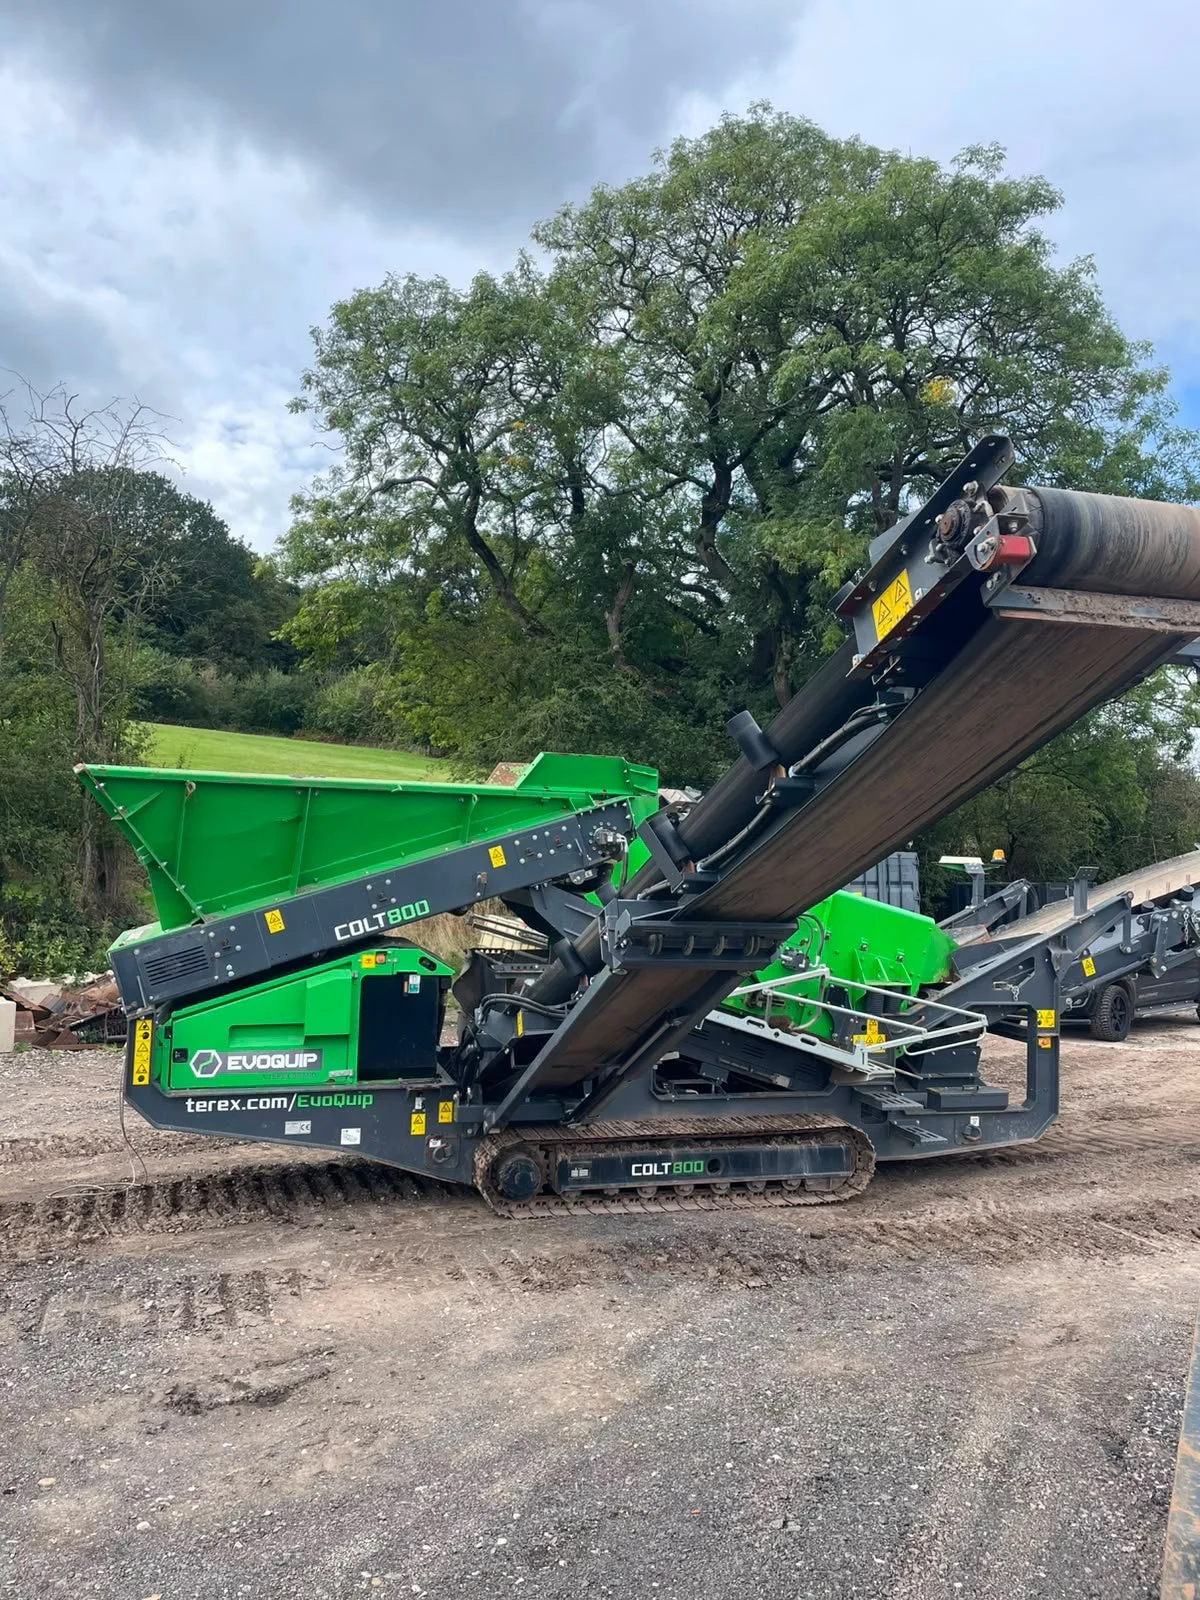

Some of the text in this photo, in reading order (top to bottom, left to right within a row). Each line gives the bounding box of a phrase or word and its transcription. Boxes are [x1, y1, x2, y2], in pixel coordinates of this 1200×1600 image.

[333, 900, 430, 940] COLT800
[227, 1053, 318, 1070] EVOQUIP
[631, 1160, 704, 1176] COLT800
